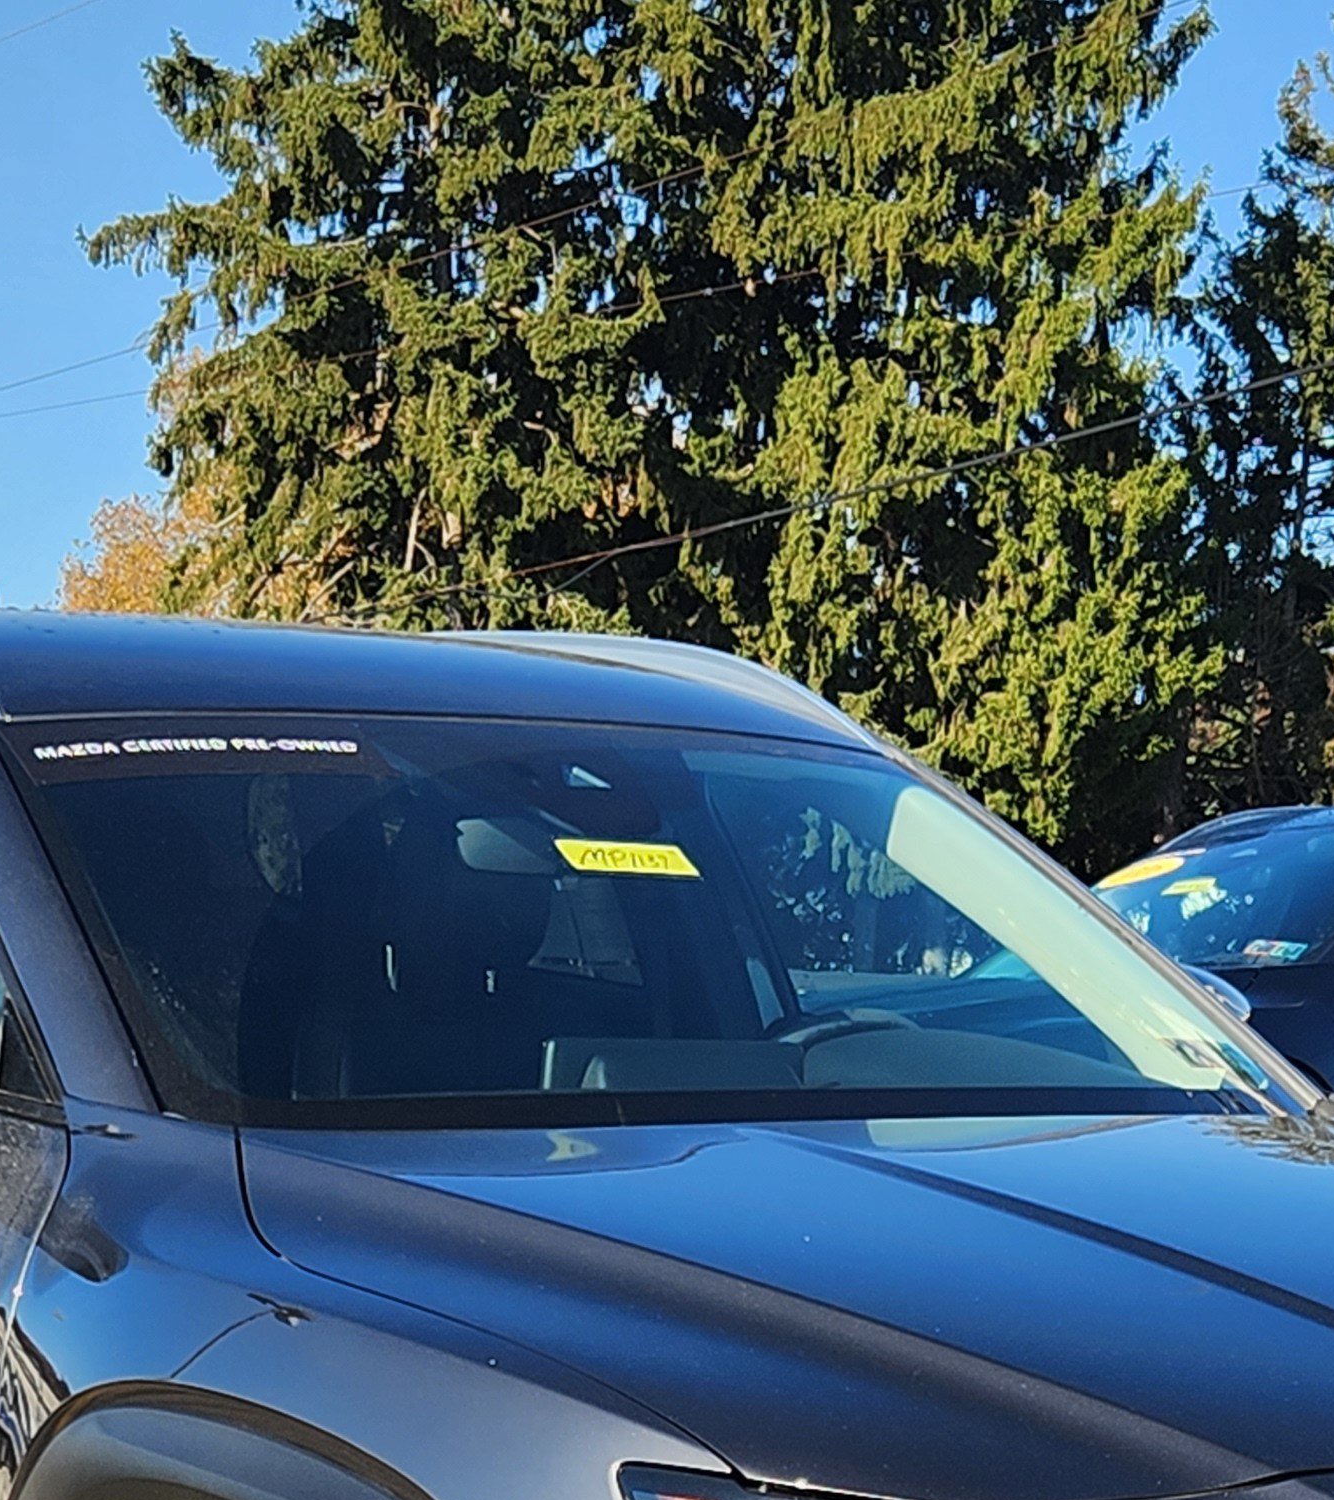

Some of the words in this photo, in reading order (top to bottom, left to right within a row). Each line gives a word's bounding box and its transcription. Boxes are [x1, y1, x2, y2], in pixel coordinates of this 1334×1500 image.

[33, 742, 120, 760] MAZDA
[122, 738, 227, 753] CERTIFIED
[230, 738, 358, 752] PRE-OWNED
